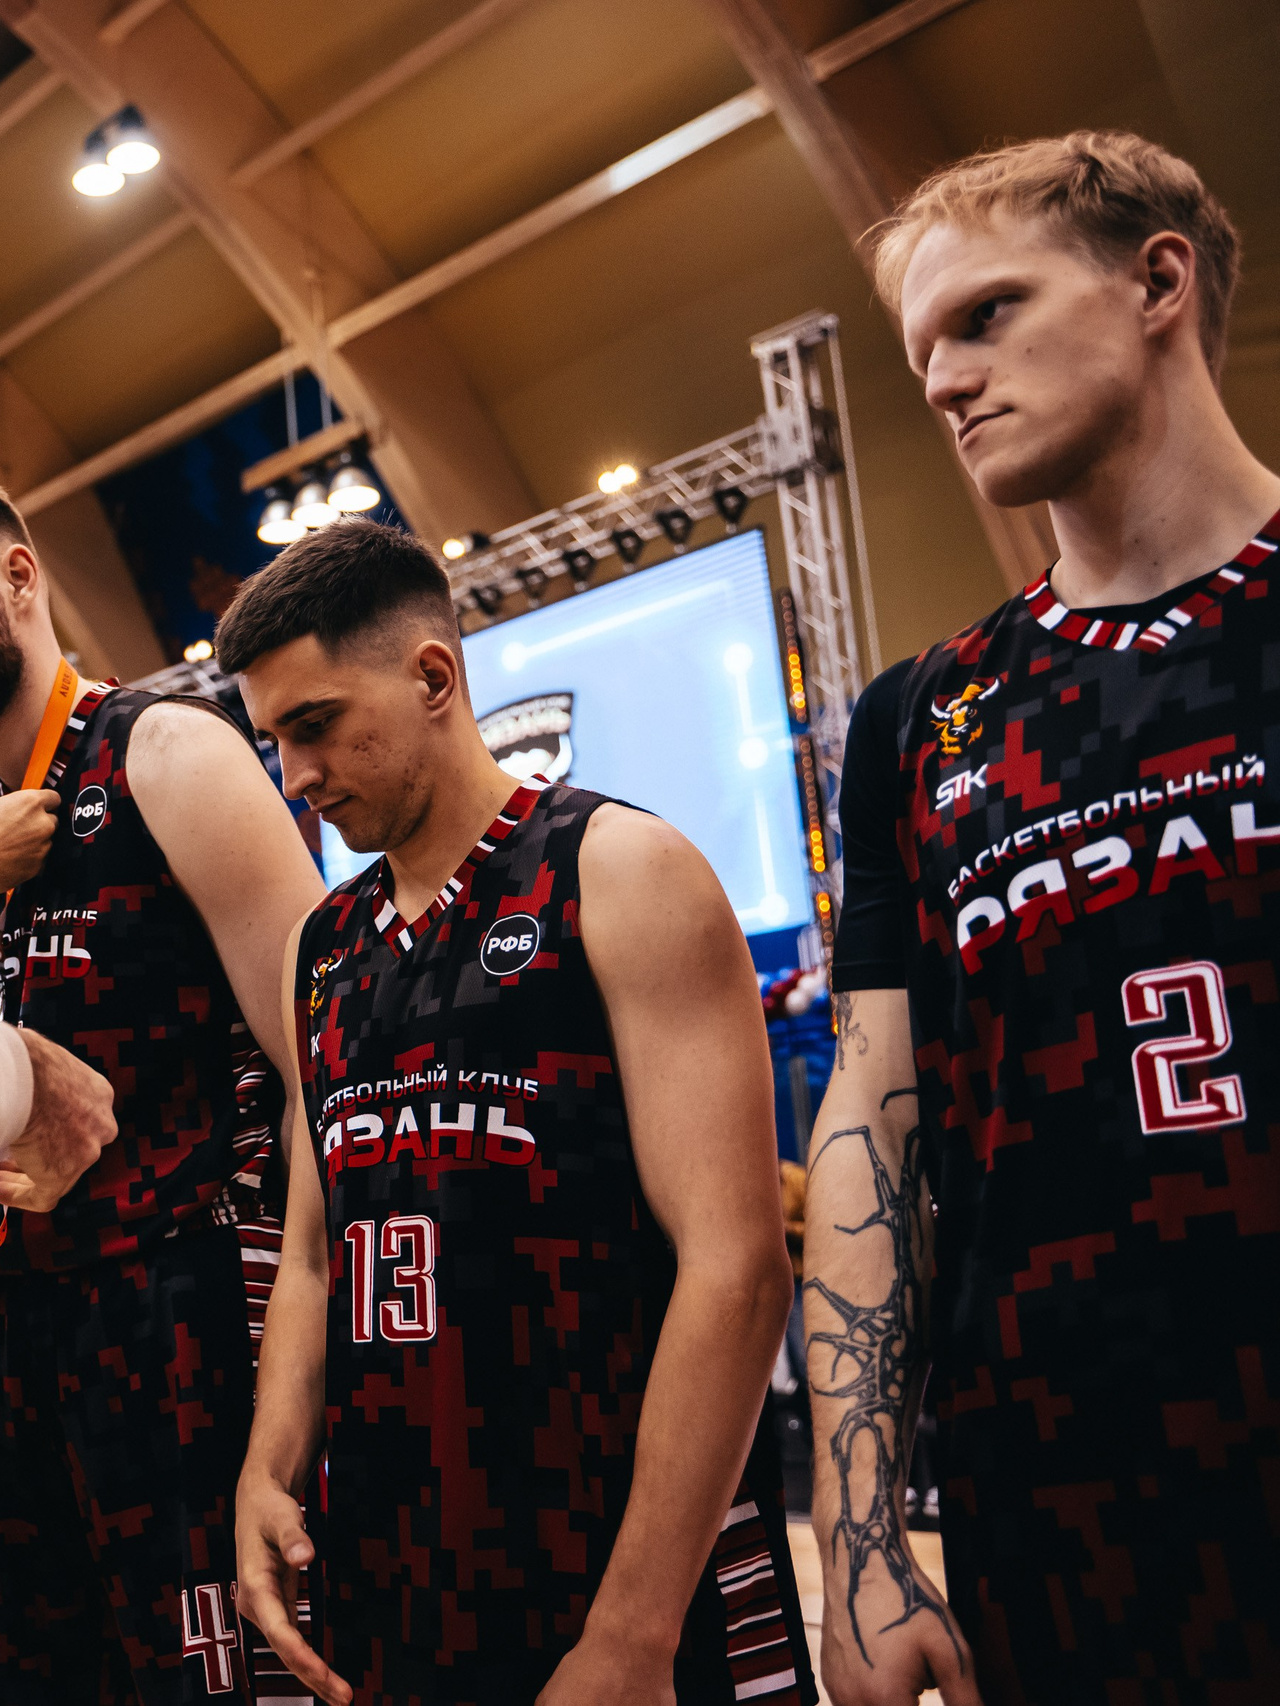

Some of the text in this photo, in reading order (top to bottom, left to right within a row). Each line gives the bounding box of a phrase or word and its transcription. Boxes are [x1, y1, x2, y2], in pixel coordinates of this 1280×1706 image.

[934, 763, 989, 810] STK
[74, 801, 104, 822] РФБ
[947, 752, 1266, 906] БАСКЕТБОЛЬНЫЙ
[52, 908, 98, 927] КЛУБ
[487, 933, 534, 955] РФБ
[1120, 960, 1248, 1136] 2
[457, 1069, 540, 1101] КЛУБ
[322, 1102, 537, 1184] ЯЗАНЬ
[344, 1214, 438, 1343] 13
